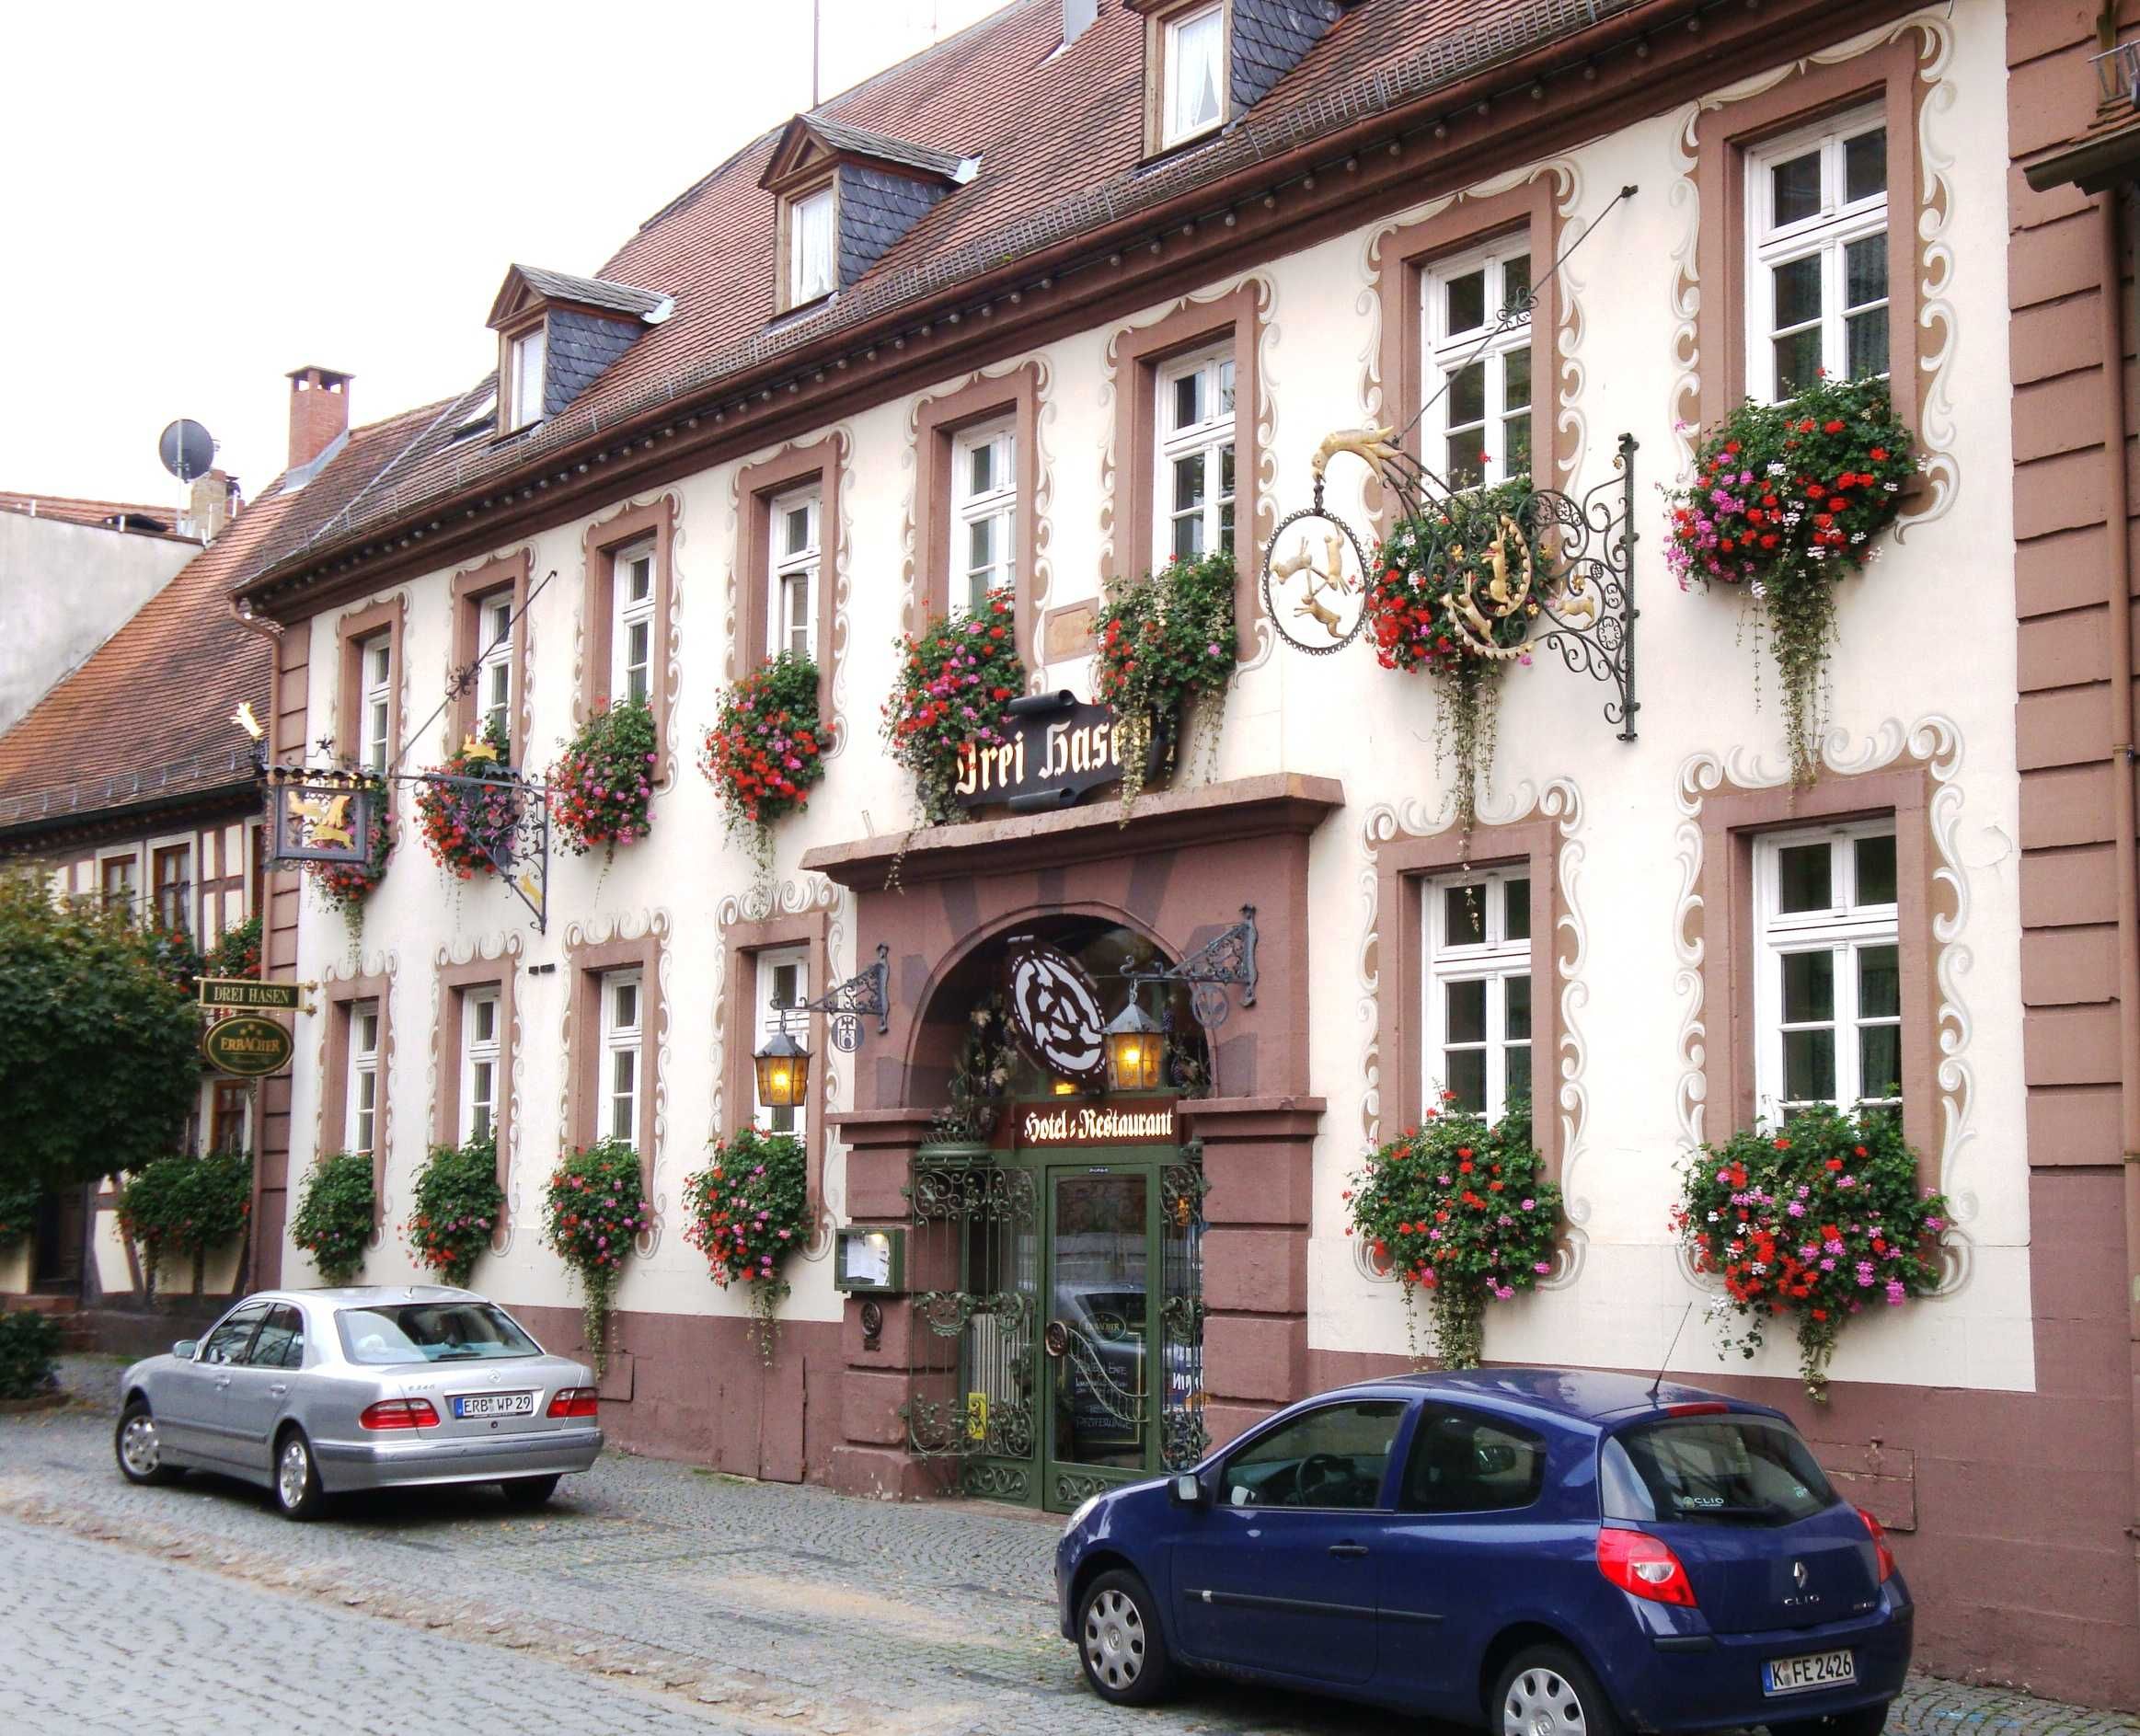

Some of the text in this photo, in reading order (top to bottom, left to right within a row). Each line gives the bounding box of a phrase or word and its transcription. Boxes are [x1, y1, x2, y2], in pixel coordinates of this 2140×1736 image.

[213, 986, 290, 1005] DREI HASEN
[221, 1036, 281, 1052] ERBACHER
[464, 1397, 530, 1413] ERB WP 29
[1784, 1594, 1820, 1605] CLIO
[1772, 1653, 1852, 1686] K FE 2426
